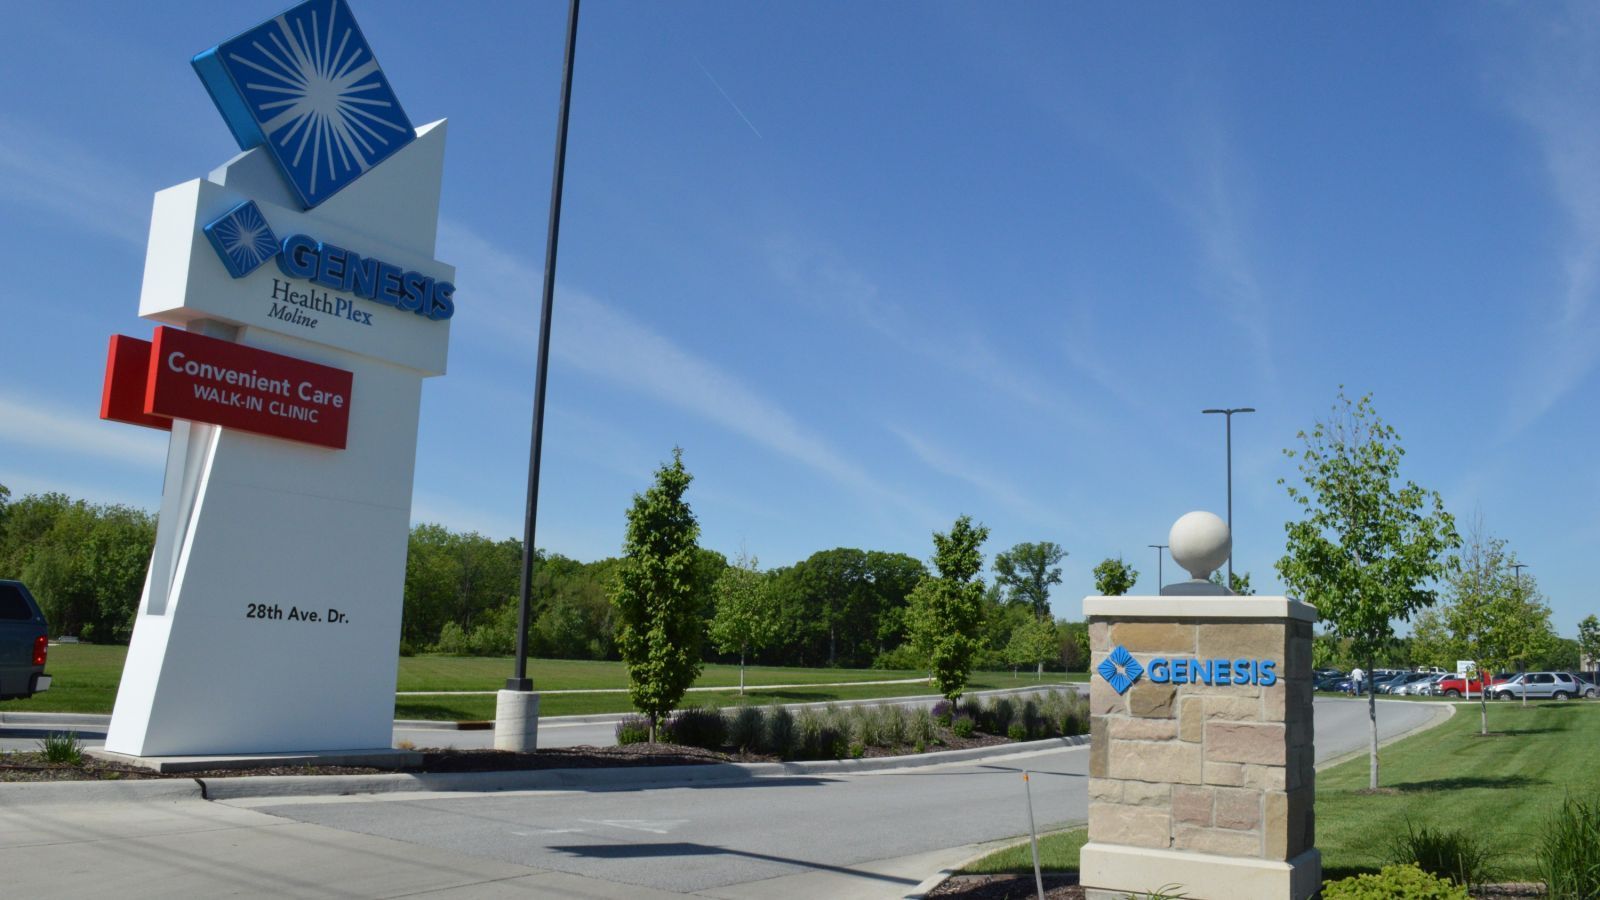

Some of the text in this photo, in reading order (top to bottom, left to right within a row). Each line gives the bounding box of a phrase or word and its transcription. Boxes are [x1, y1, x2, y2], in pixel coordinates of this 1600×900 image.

[276, 234, 455, 320] GENESIS
[267, 302, 319, 329] Moline
[272, 278, 374, 326] HealthPlex
[167, 351, 344, 408] Convenient Care
[193, 383, 320, 424] WALK-IN CLINIC
[246, 603, 349, 624] 28th Ave. Dr.
[1147, 658, 1277, 687] GENESIS
